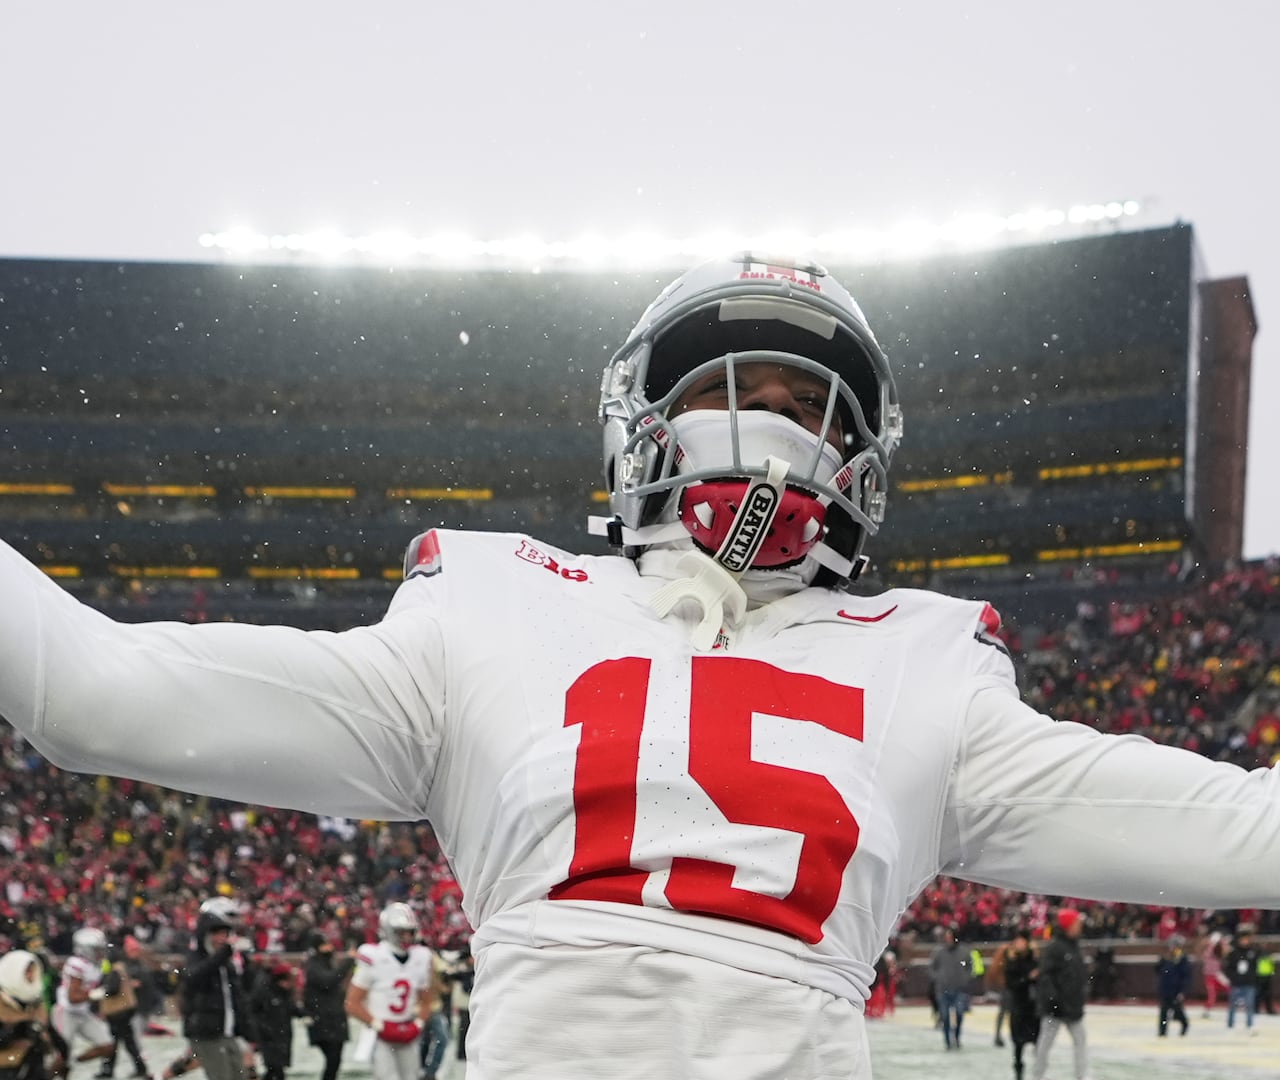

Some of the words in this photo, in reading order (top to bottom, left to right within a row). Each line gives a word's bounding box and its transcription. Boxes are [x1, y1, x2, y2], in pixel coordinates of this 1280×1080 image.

[722, 492, 772, 569] BATTLE
[548, 656, 864, 944] 15
[387, 978, 411, 1015] 3
